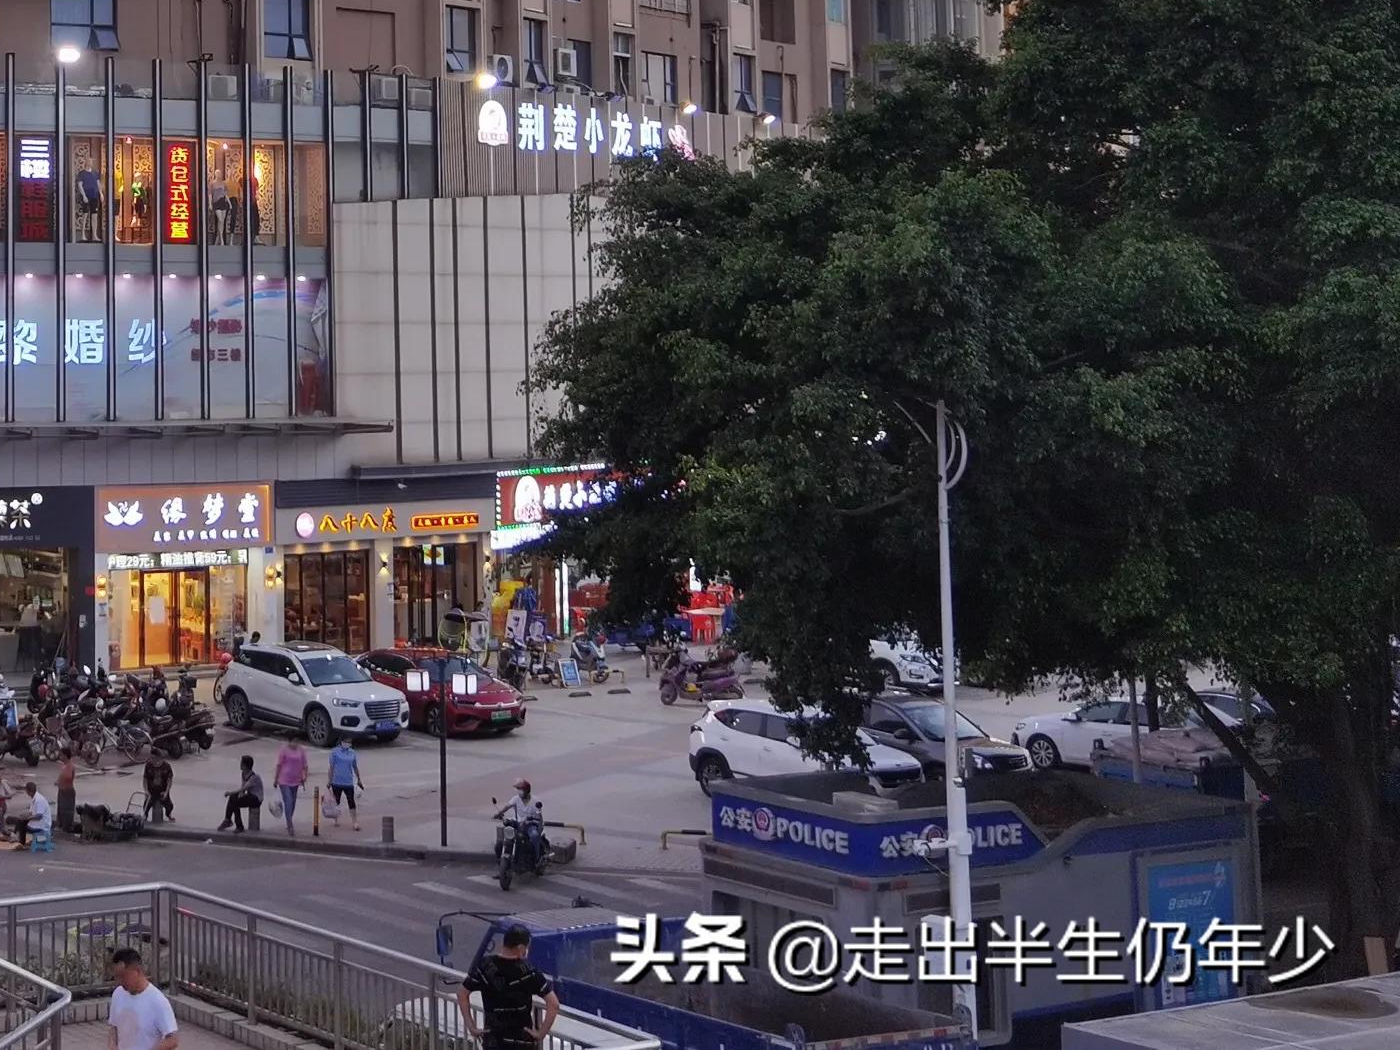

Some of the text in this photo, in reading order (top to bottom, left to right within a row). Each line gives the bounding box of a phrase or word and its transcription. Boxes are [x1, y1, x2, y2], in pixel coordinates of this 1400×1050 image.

[169, 147, 191, 239] 货仓式经营
[720, 805, 849, 854] 公安 POLICE
